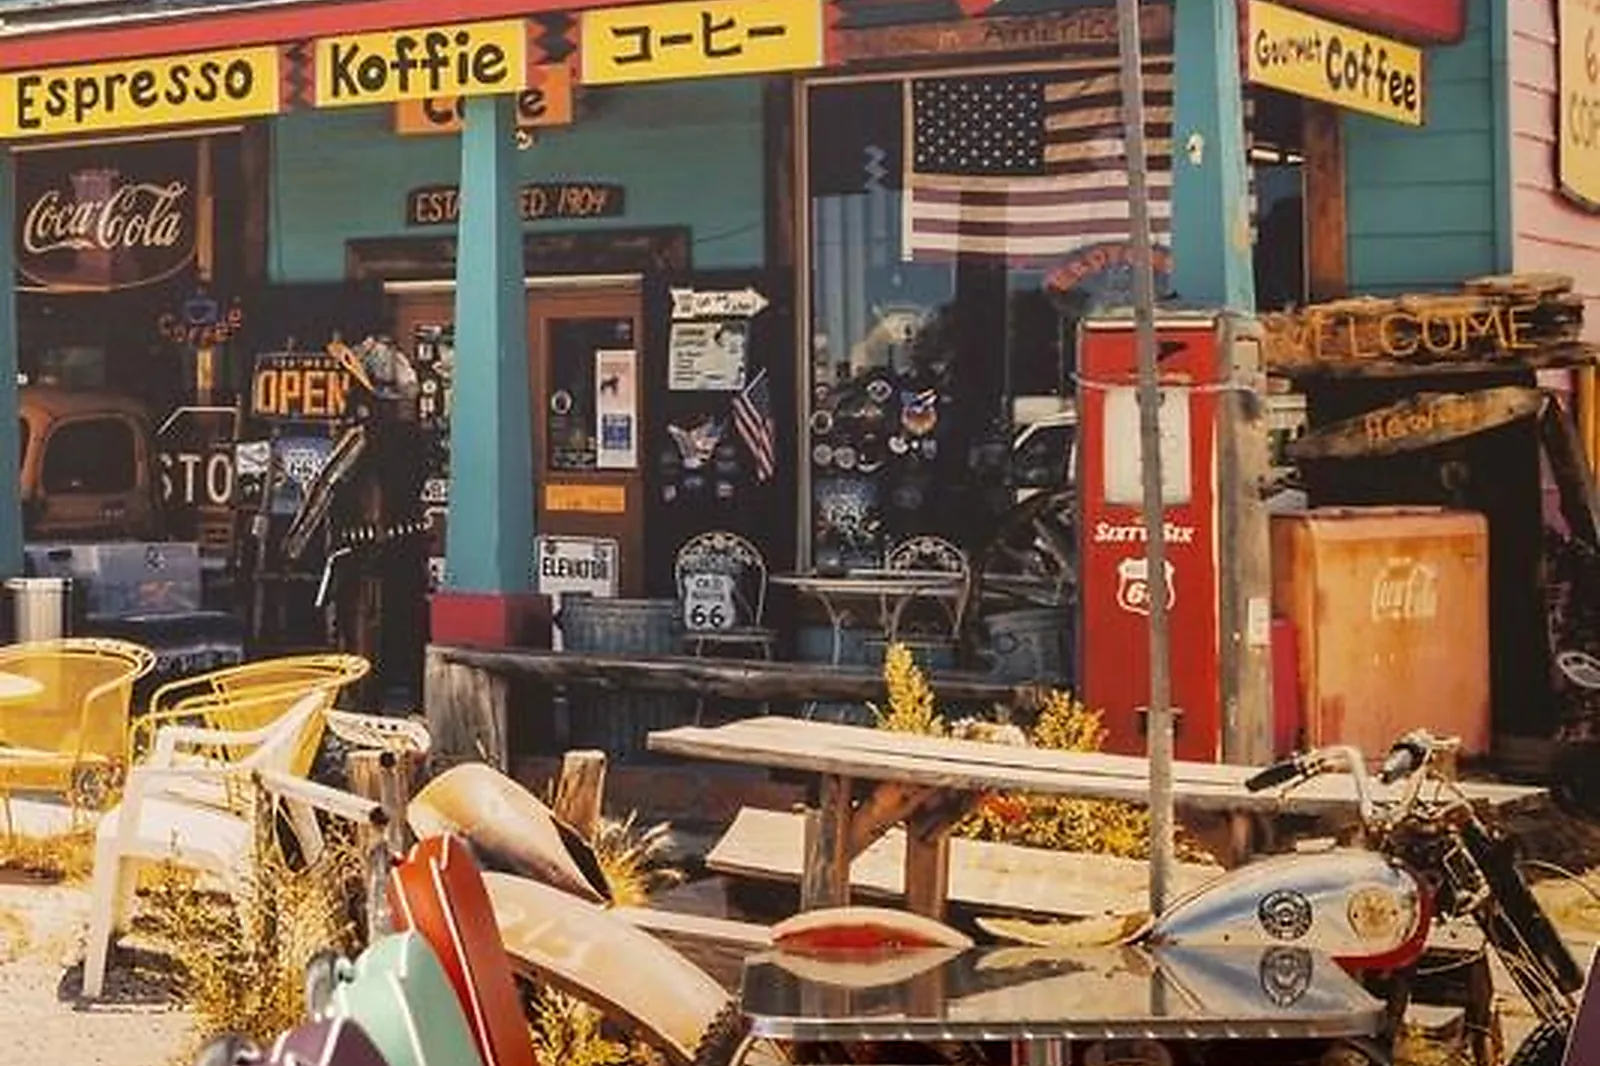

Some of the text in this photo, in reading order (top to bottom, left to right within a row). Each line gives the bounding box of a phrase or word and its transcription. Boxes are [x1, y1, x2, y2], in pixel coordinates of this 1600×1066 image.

[331, 32, 508, 98] Koffie
[612, 11, 786, 65] コーヒー
[17, 59, 253, 130] Espresso
[1326, 36, 1417, 111] Coffee
[1264, 303, 1538, 359] WELCOME
[257, 369, 350, 417] OPEN
[691, 604, 725, 627] 66
[1126, 582, 1152, 604] 6
